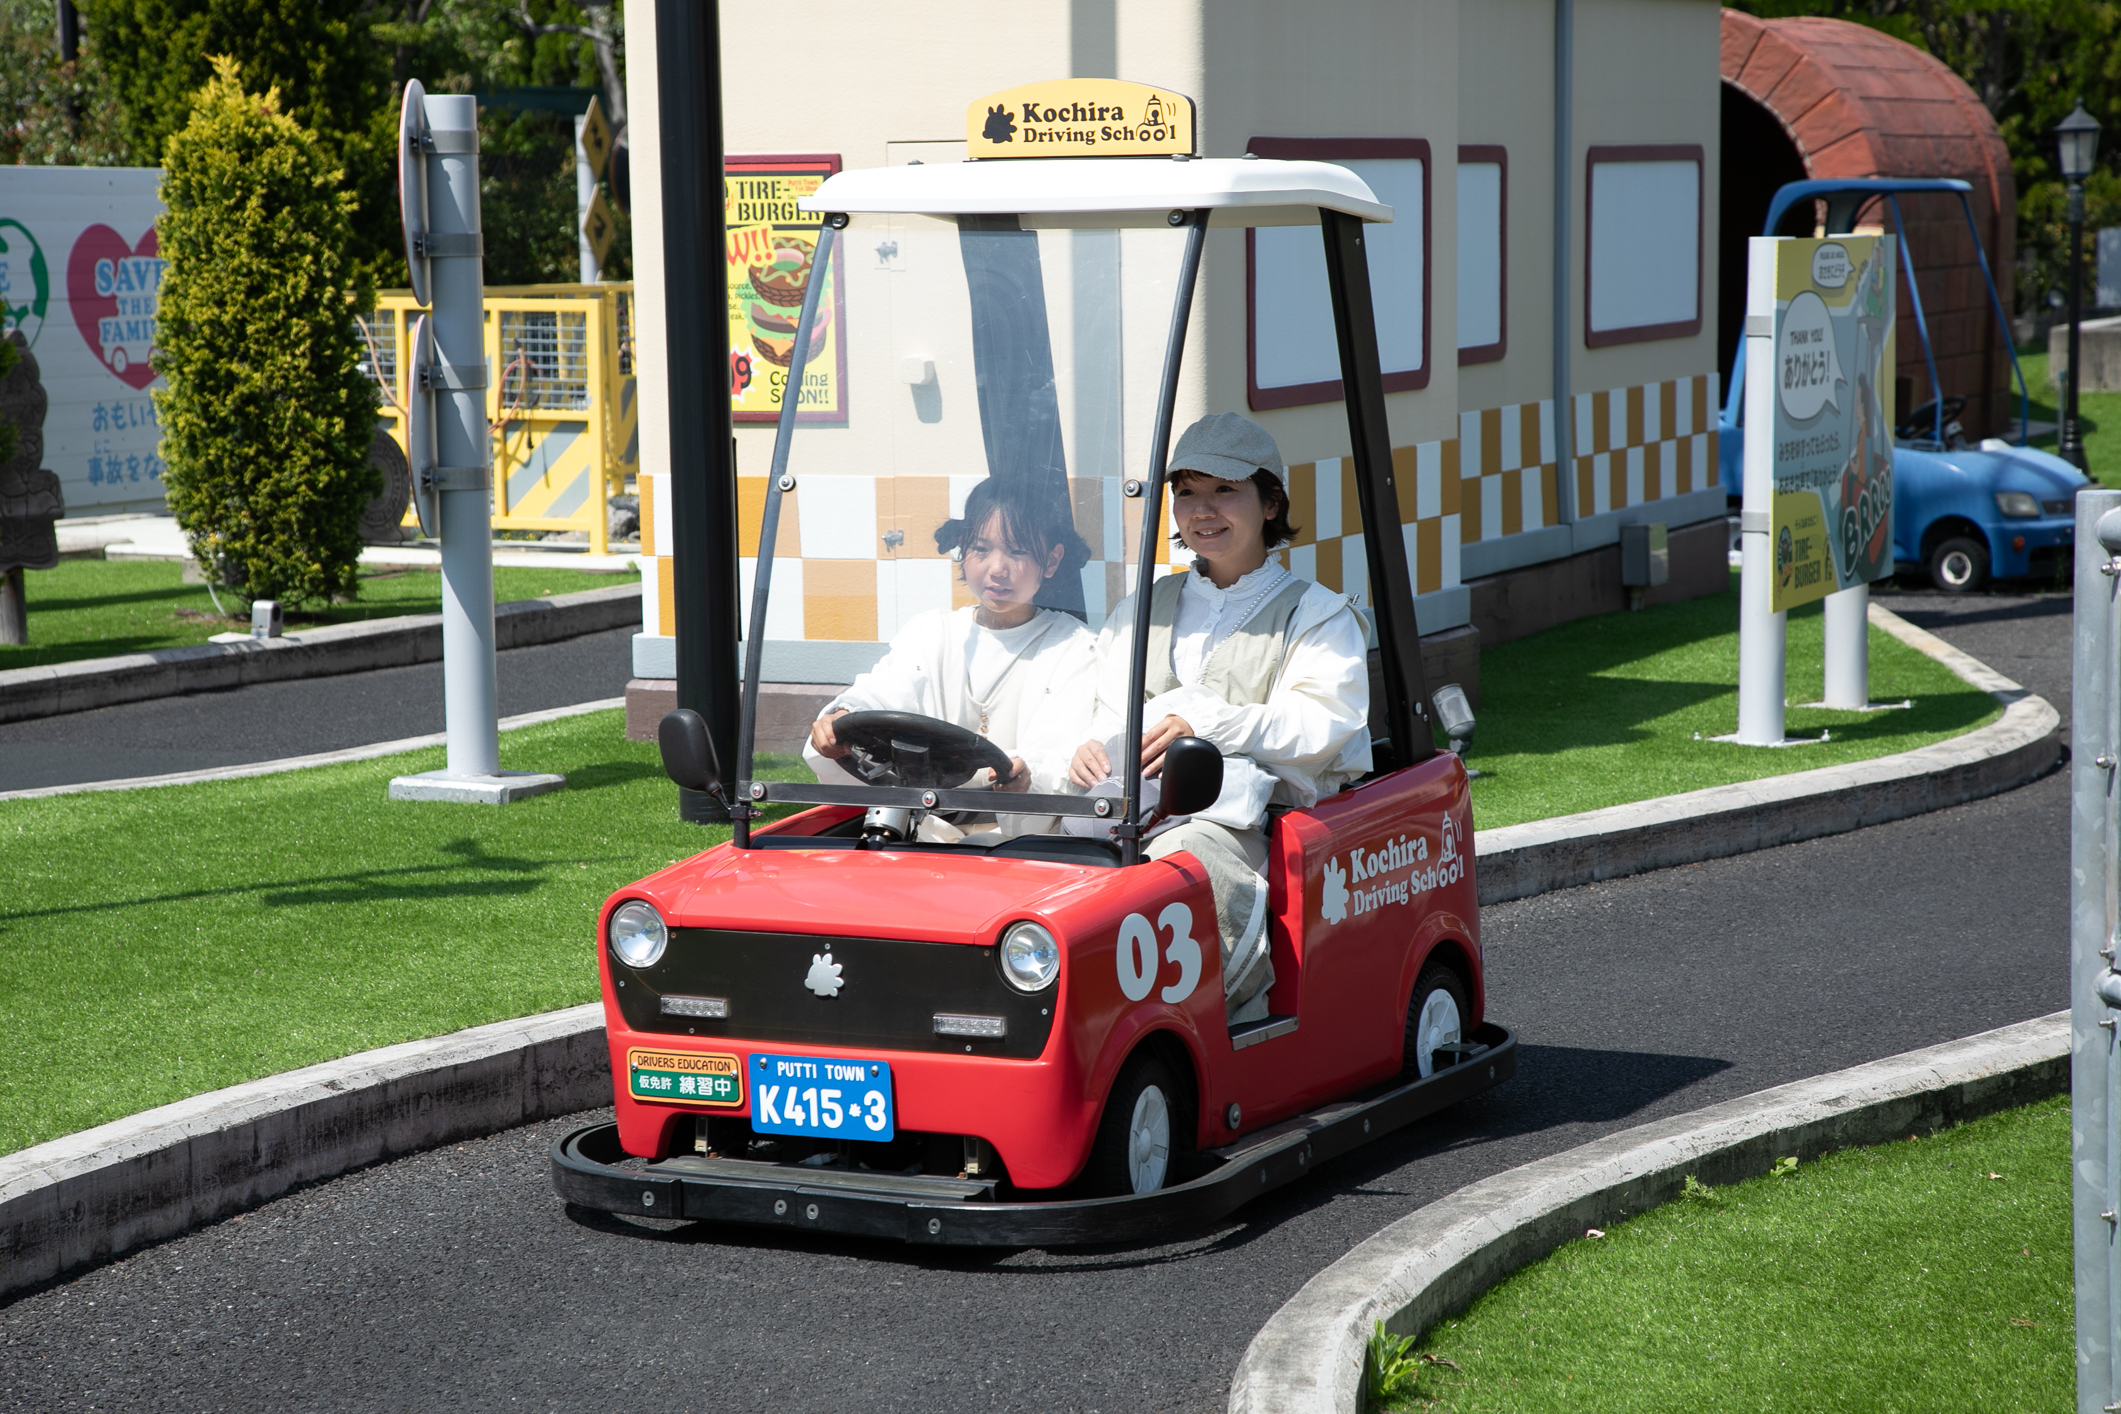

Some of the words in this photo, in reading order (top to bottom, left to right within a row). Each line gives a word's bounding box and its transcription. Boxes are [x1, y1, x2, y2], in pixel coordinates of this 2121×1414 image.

[1022, 102, 1125, 123] Kochira
[1023, 127, 1096, 146] Driving
[1101, 125, 1177, 142] School
[736, 181, 790, 200] TIRE-
[119, 298, 152, 316] THE
[1790, 330, 1809, 346] THANK
[730, 356, 752, 389] 9
[770, 371, 828, 388] Coing
[1794, 560, 1821, 589] BURGER
[1350, 834, 1429, 884] Kochira
[1353, 880, 1409, 916] Driving
[1411, 854, 1465, 895] School
[1116, 902, 1202, 1004] 03
[637, 1055, 675, 1070] DRIVERS
[678, 1059, 731, 1073] EDUCATION
[777, 1061, 817, 1079] PUTTI
[825, 1064, 865, 1082] TOWN
[638, 1075, 673, 1091] 仮免許
[679, 1076, 732, 1097] 練習中
[759, 1084, 844, 1129] K415
[863, 1089, 887, 1132] 3
